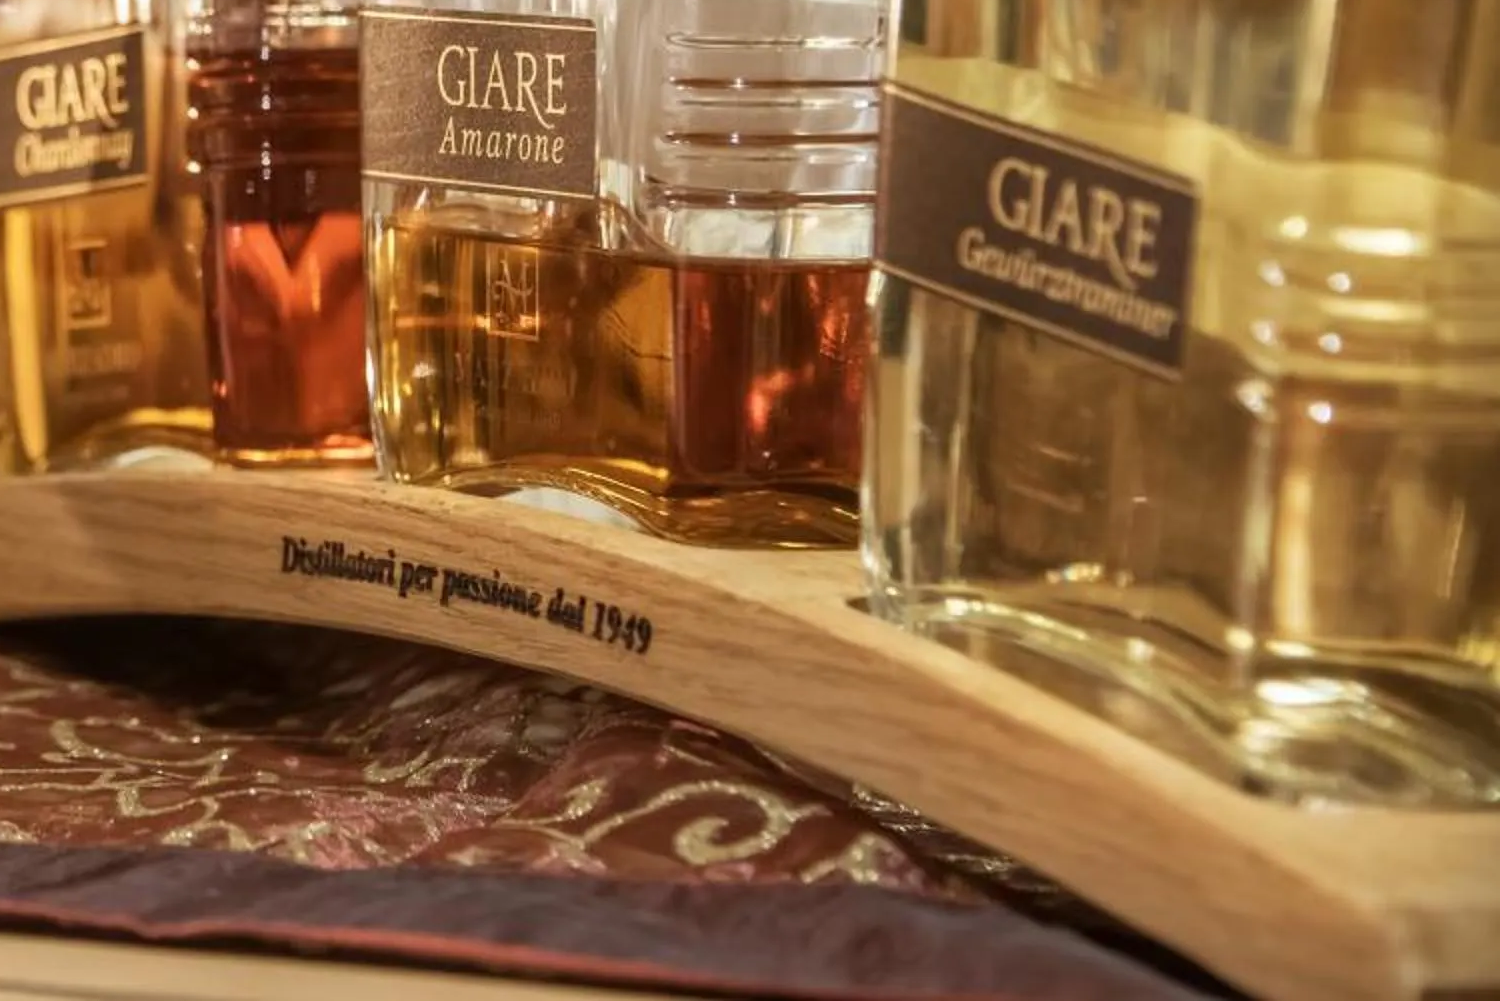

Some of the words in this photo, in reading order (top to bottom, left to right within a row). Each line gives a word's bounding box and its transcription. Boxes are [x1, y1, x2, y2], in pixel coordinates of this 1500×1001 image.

[15, 52, 130, 131] GIARE
[437, 44, 567, 130] GIARE
[437, 115, 566, 165] Amarone
[987, 155, 1163, 291] GIARE
[280, 535, 397, 589] Distillatori
[397, 559, 439, 599] per
[440, 567, 543, 619] passione
[546, 586, 588, 639] dal
[592, 600, 654, 655] 1949
